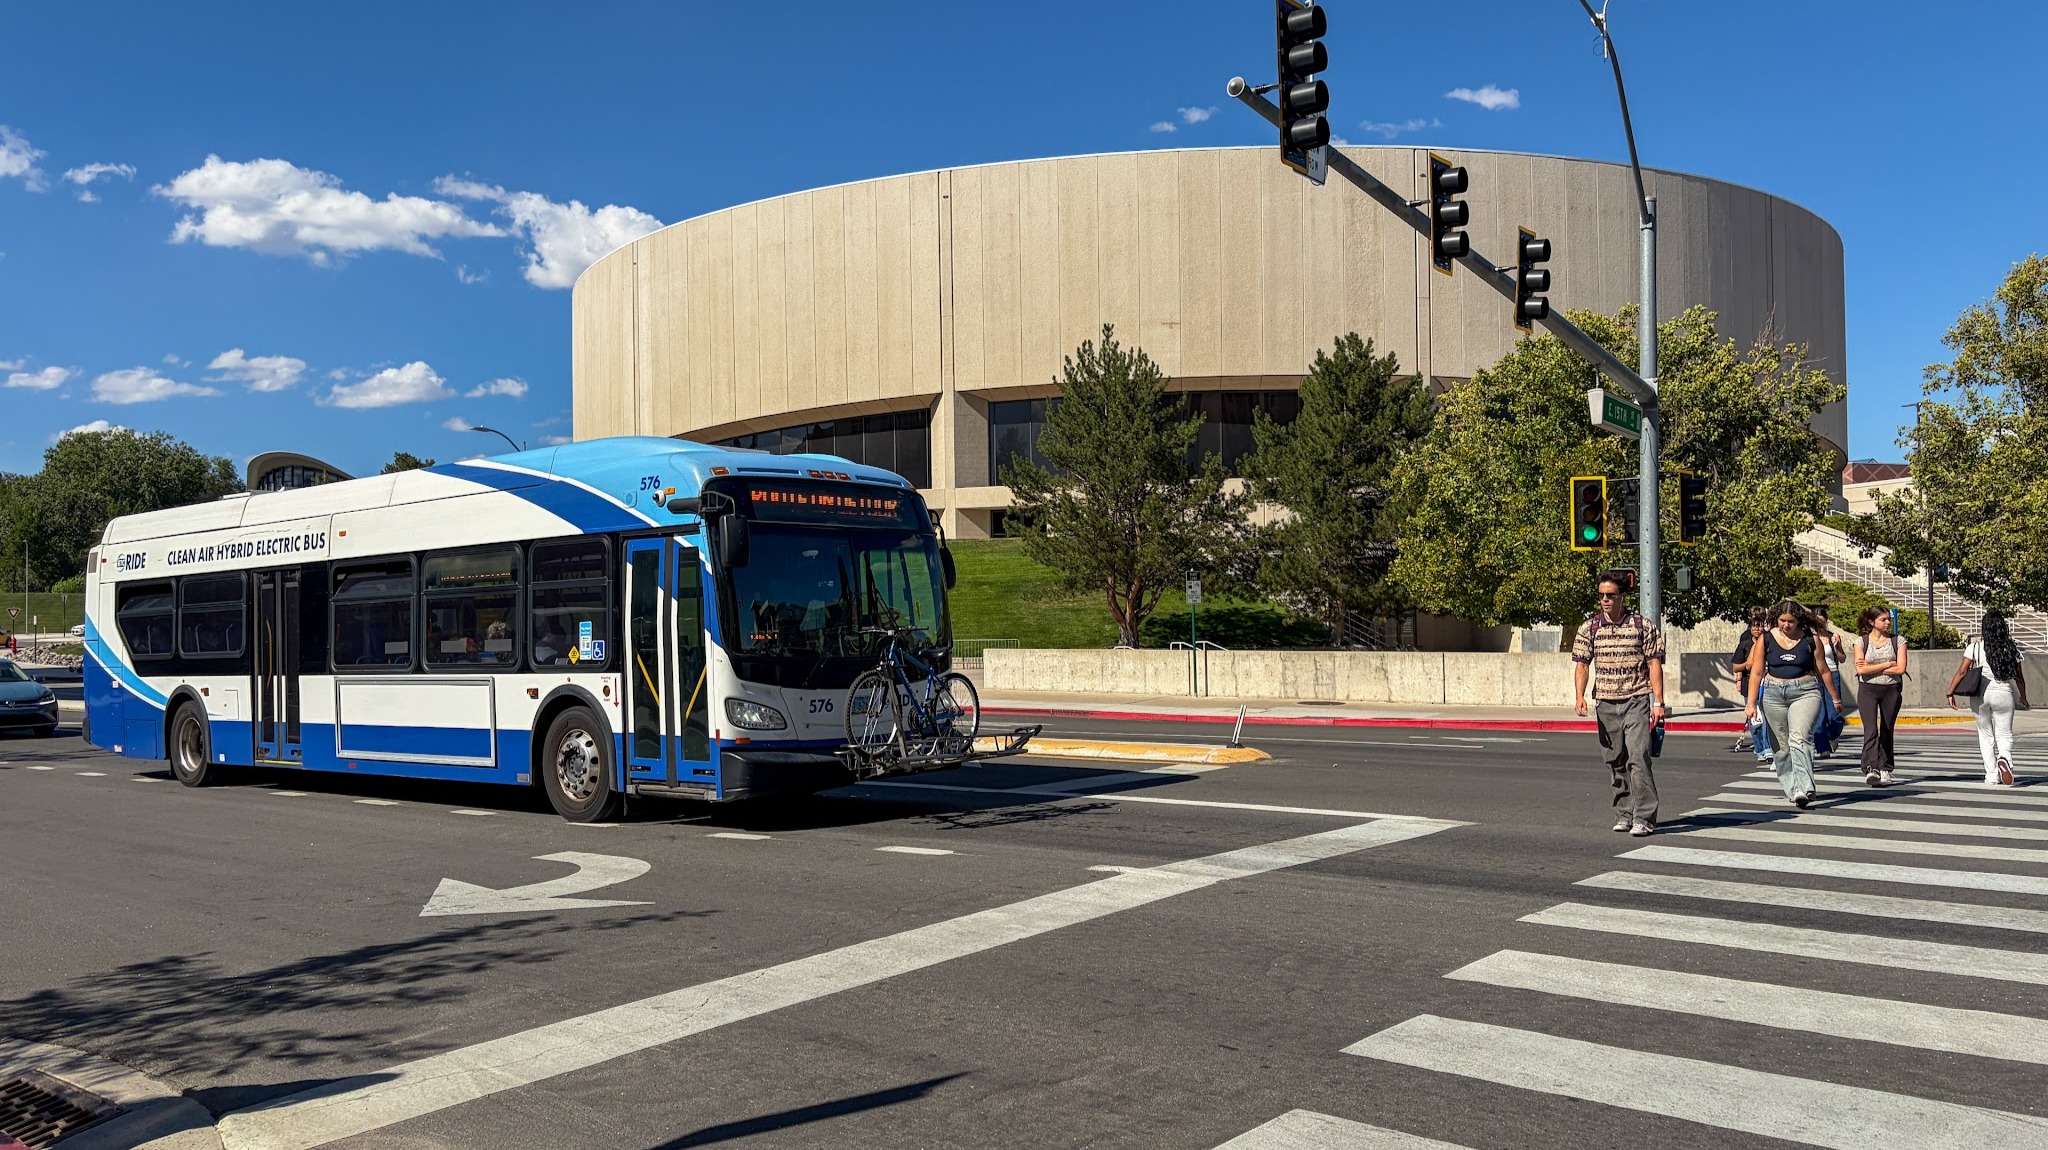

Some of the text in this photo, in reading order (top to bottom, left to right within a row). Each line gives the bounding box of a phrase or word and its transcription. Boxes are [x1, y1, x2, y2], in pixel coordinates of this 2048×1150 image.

[640, 475, 660, 491] 576
[167, 532, 326, 566] CLEAN AIR HYBRID ELECTRIC BUS
[125, 552, 147, 571] RIDE
[809, 698, 834, 713] 576
